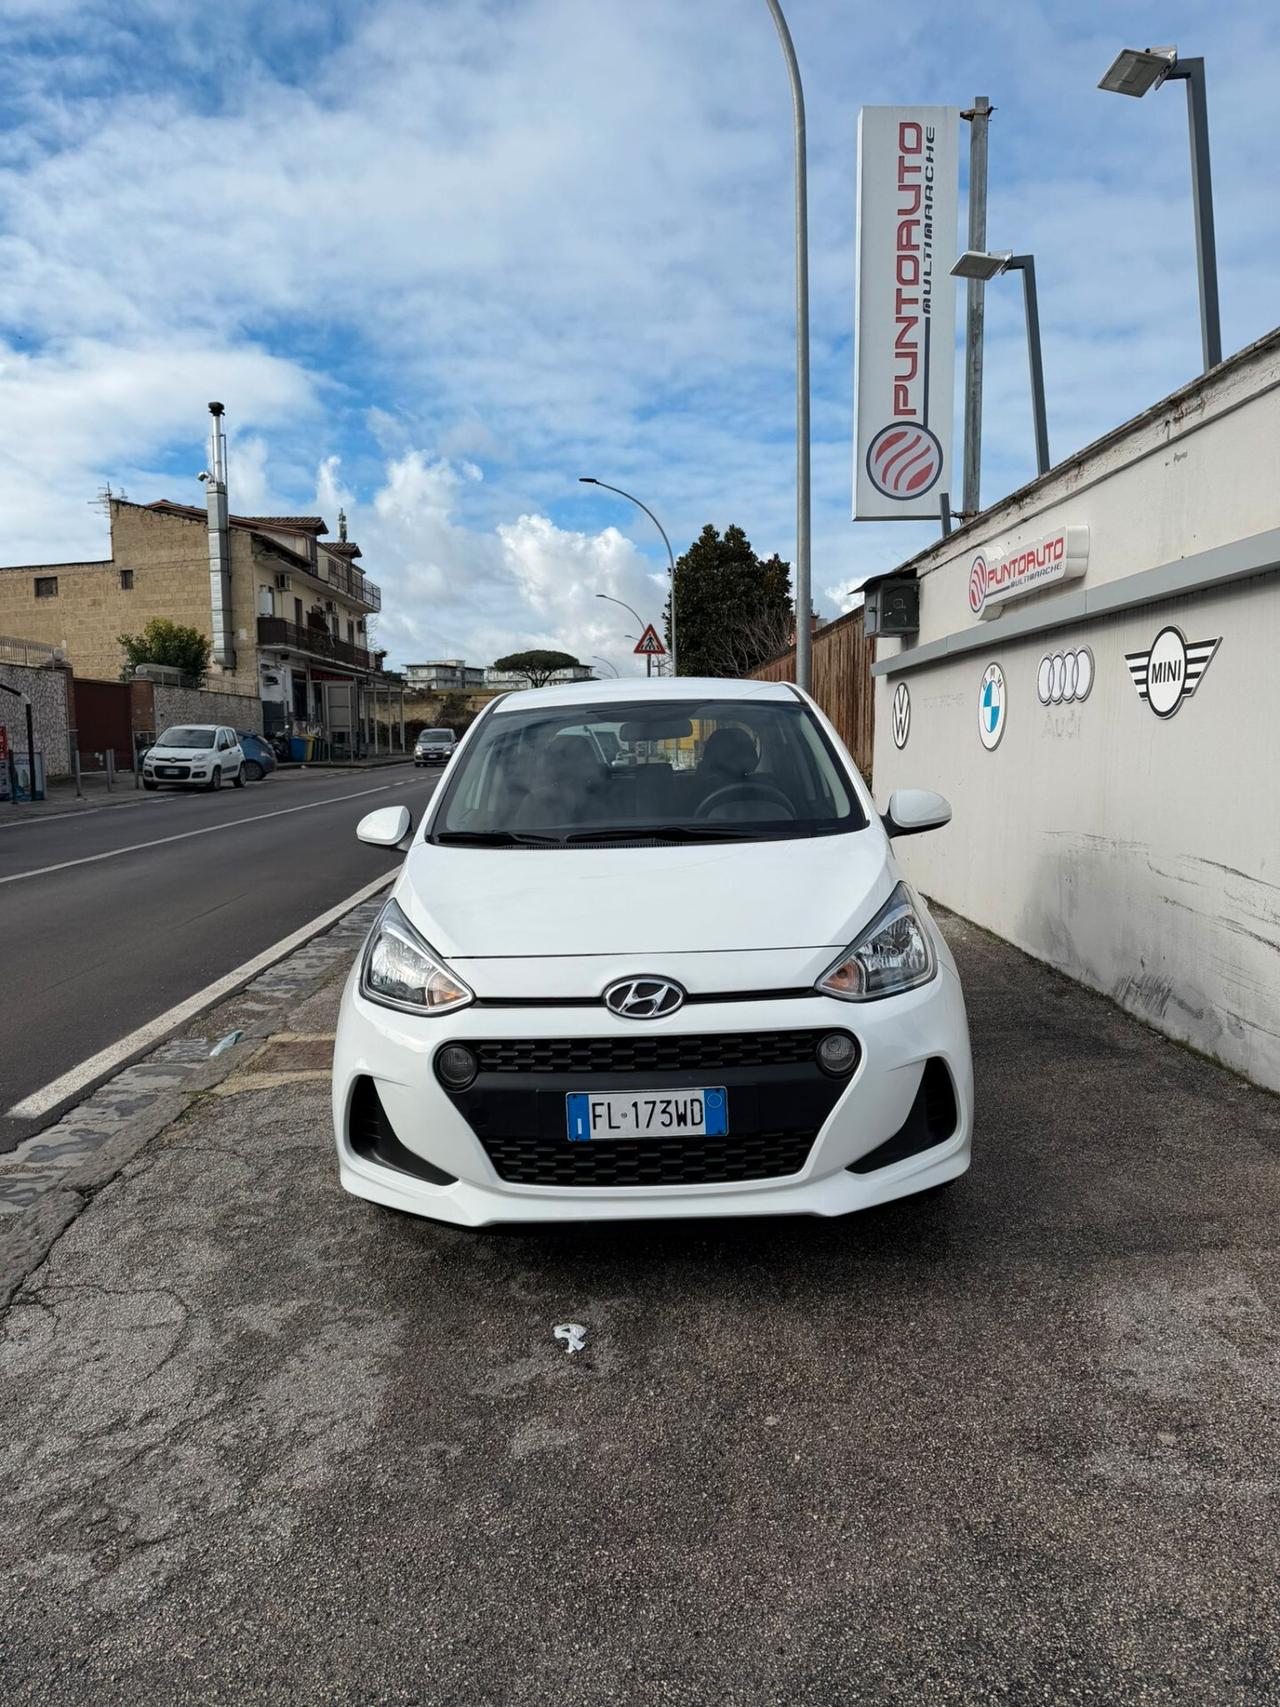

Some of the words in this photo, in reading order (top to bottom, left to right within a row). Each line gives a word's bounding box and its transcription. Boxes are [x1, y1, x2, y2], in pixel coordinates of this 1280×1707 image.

[923, 126, 935, 314] MULTIMARCHE
[894, 122, 923, 416] PUNTOAUTO
[987, 537, 1064, 588] PUNTOAUTO
[1010, 561, 1063, 588] MULTIMARCHE
[1151, 659, 1182, 684] MINI
